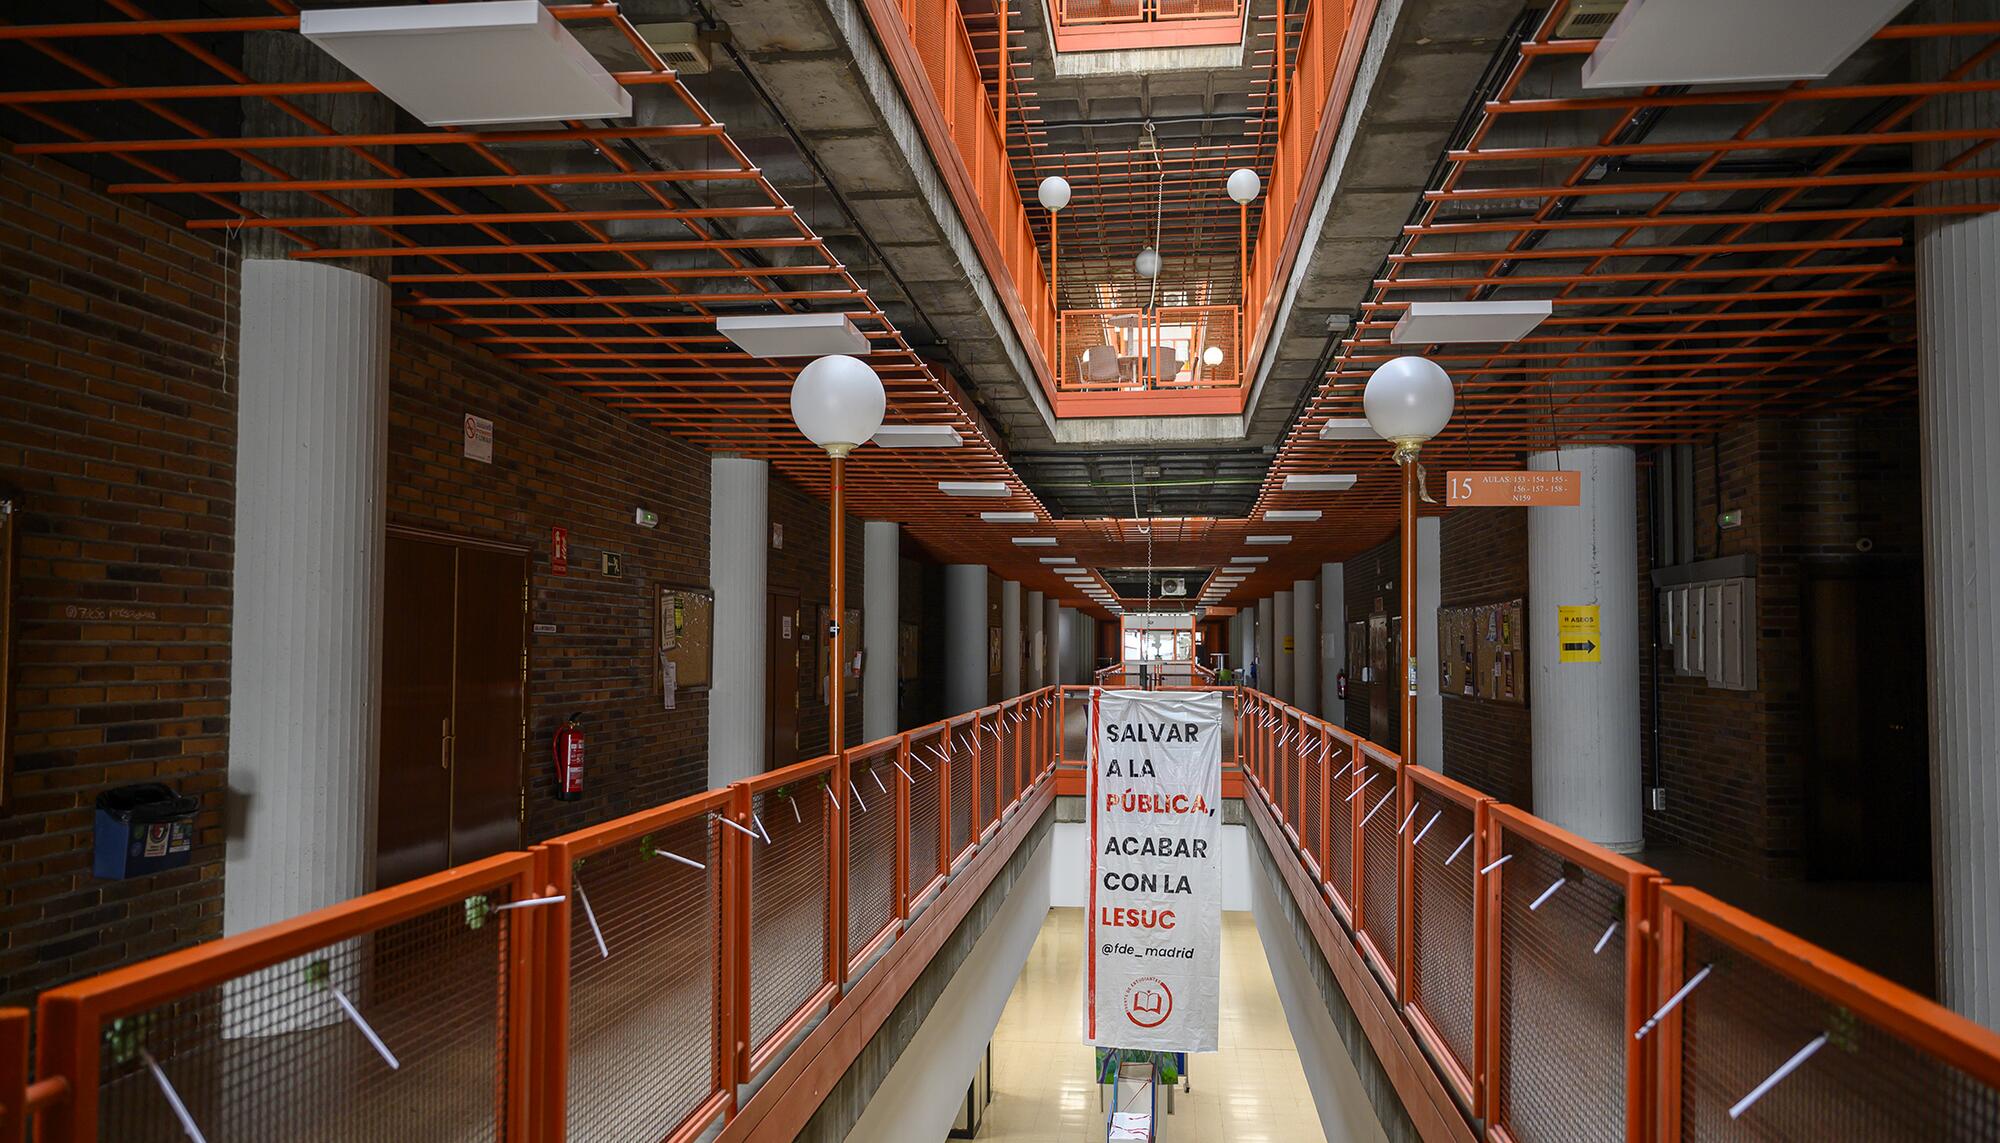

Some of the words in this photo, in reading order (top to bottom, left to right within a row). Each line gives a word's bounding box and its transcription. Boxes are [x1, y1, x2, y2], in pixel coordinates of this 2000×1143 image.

[1451, 478, 1472, 499] 15
[1512, 494, 1531, 502] N159
[1513, 485, 1526, 493] 156
[1532, 485, 1544, 493] 157
[1106, 723, 1199, 743] SALVAR
[1106, 759, 1122, 777] A
[1129, 759, 1156, 778] LA
[1105, 788, 1215, 817] PÚBLICA,
[1104, 836, 1208, 858] ACABAR
[1103, 872, 1157, 893] CON
[1163, 874, 1192, 894] LA
[1101, 906, 1176, 929] LESUC
